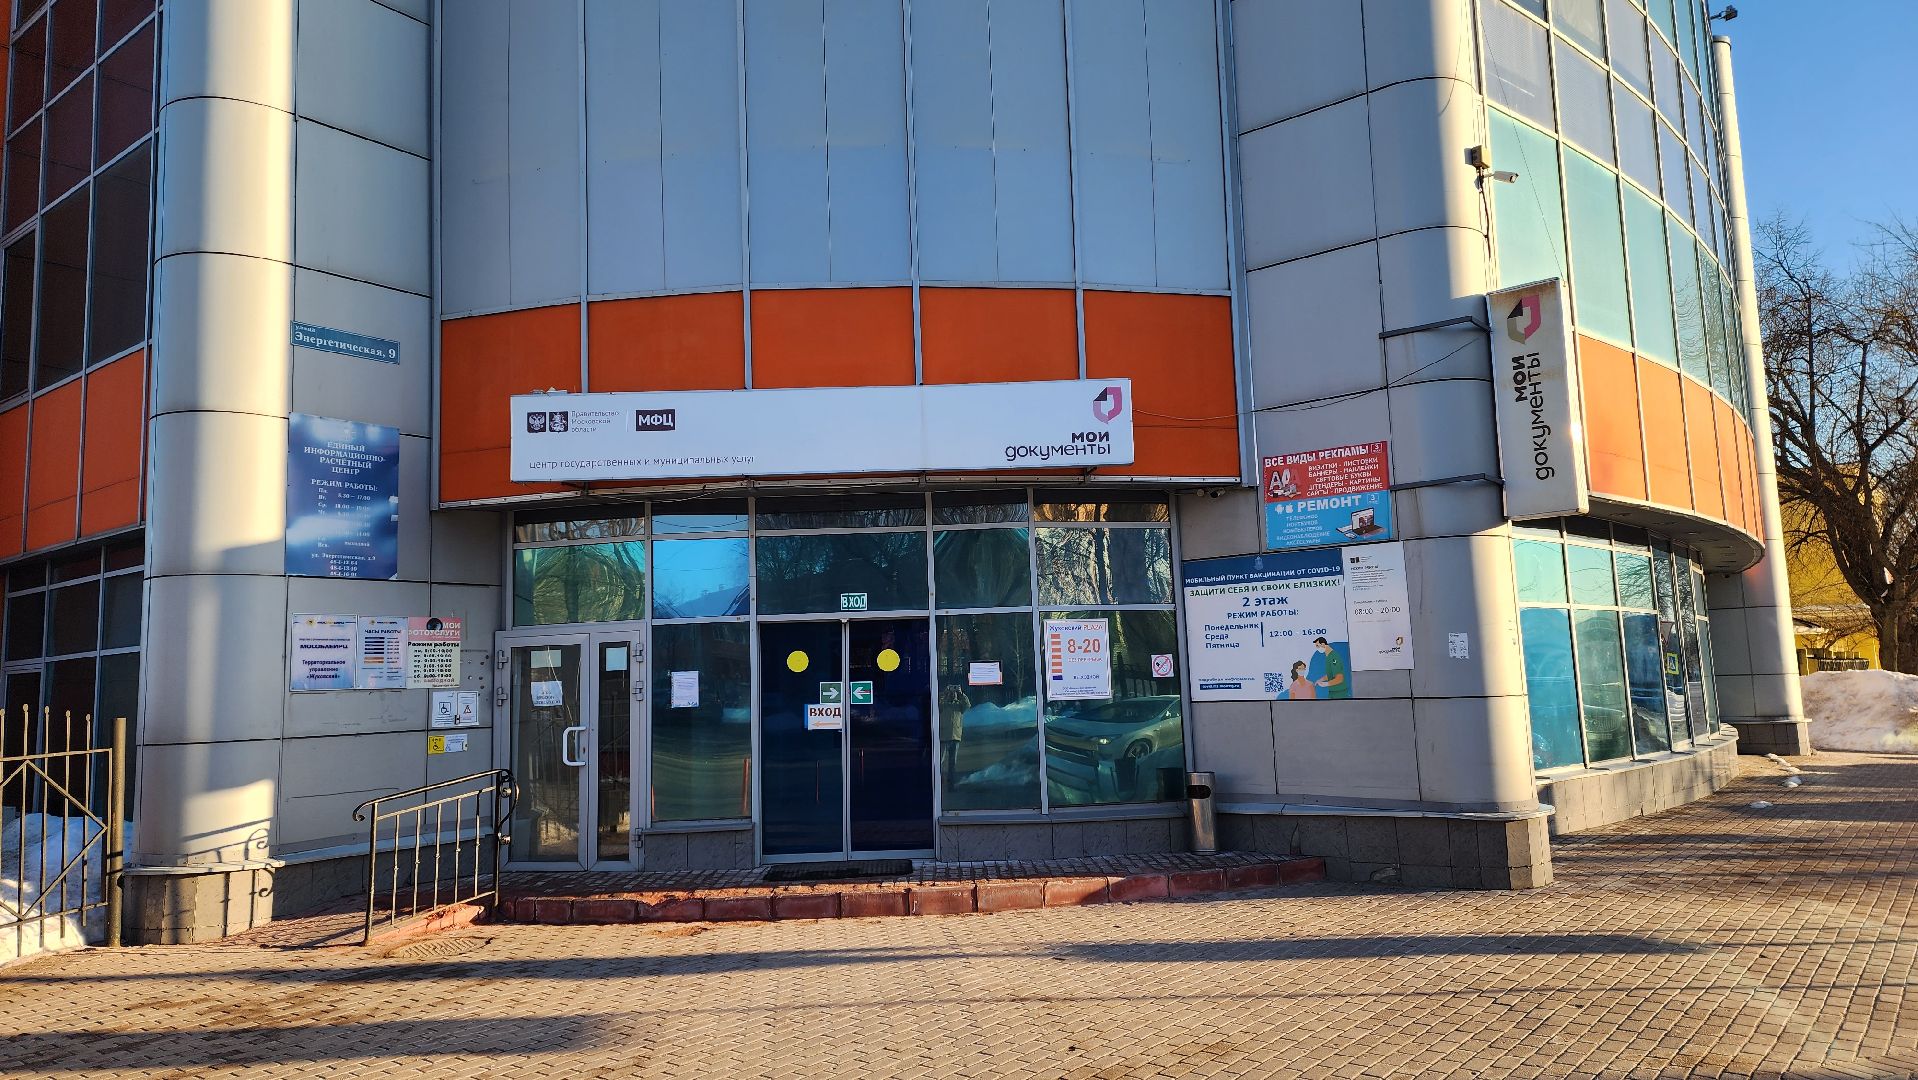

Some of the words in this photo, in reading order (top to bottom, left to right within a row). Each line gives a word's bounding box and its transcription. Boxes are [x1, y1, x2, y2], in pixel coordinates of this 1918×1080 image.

[294, 331, 385, 358] Энергетическая,
[388, 348, 396, 359] 9
[571, 411, 620, 421] Правительство
[638, 413, 674, 427] МФЦ
[1527, 352, 1555, 481] документы
[327, 441, 366, 452] ЕДИНЫЙ
[1005, 443, 1111, 461] документы
[304, 446, 386, 463] ИНФОРМАЦИОННО-
[1264, 457, 1285, 468] ВСЕ
[1286, 453, 1316, 466] ВИДЫ
[1318, 446, 1369, 461] РЕКЛАМЫ
[529, 461, 557, 471] центр
[560, 457, 642, 469] государственных
[653, 456, 729, 468] муниципальных
[731, 455, 755, 465] услуг
[1308, 463, 1338, 474] ВИЗИТКИ
[1343, 457, 1378, 469] ЛИСТОВКИ
[331, 466, 360, 476] ЦЕНТР
[1308, 469, 1338, 480] БАННЕРЫ
[1343, 464, 1379, 475] НАКЛЕЙКИ
[1315, 474, 1349, 483] СВЕТОВЫЕ
[1350, 471, 1372, 480] БУКВЫ
[311, 478, 342, 488] РЕЖИМ
[344, 482, 378, 492] РАБОТЫ:
[1306, 489, 1329, 497] САЙТЫ
[1334, 482, 1383, 494] ПРОДВИЖЕНИЕ
[1309, 481, 1344, 491] ШТЕНДЕРЫ
[1349, 477, 1381, 487] КАРТИНЫ
[1297, 495, 1361, 513] РЕМОНТ
[1184, 573, 1226, 585] МОБИЛЬНЫЙ
[1227, 573, 1249, 581] ПУНКТ
[1249, 569, 1295, 579] ВАКЦИНАЦИИ
[1307, 565, 1341, 575] COVID-19
[1189, 588, 1226, 598] ЗАЩИТИ
[1227, 586, 1250, 594] СЕБЯ
[1261, 582, 1291, 592] СВОИХ
[1293, 578, 1341, 590] БЛИЗКИХ!
[841, 596, 866, 608] ВХОД
[1242, 597, 1251, 607] 2
[1254, 596, 1289, 606] этаж
[1227, 610, 1258, 620] РЕЖИМ
[1260, 608, 1299, 618] РАБОТЫ:
[1381, 606, 1401, 614] 20:00
[1204, 622, 1260, 633] Понедельник
[1269, 629, 1293, 638] 12:00
[1302, 627, 1328, 636] 16:00
[1205, 633, 1230, 642] Среда
[434, 641, 459, 650] работы
[1067, 638, 1101, 654] 8-20
[1205, 642, 1240, 650] Пятница
[810, 707, 842, 718] ВХОД
